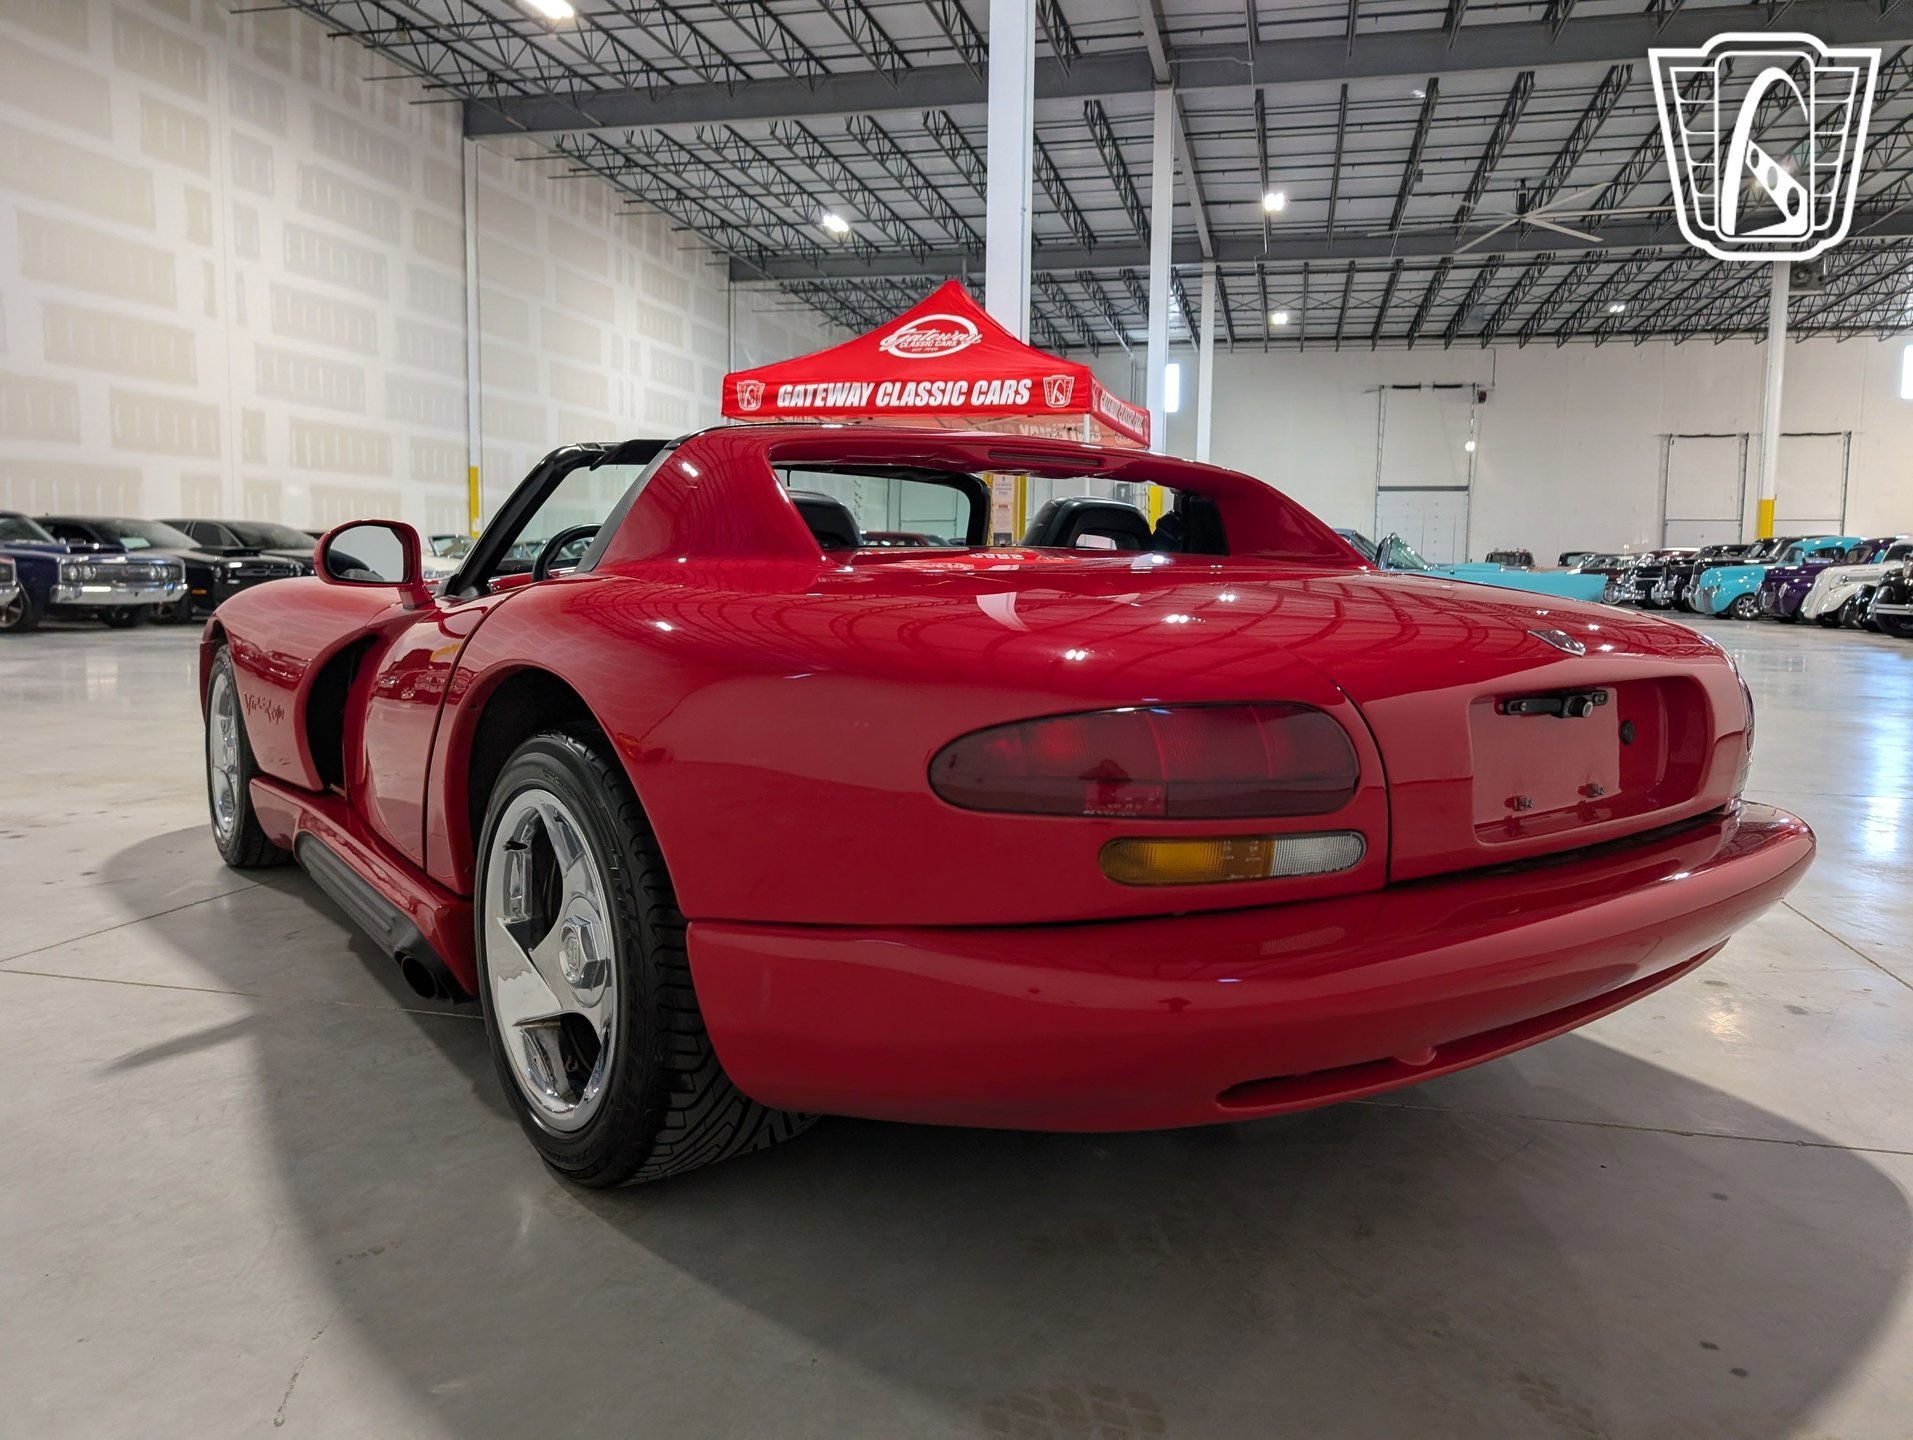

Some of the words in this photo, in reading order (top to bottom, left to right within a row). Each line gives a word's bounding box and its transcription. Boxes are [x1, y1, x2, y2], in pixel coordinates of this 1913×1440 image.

[879, 328, 983, 352] Gateway
[900, 340, 934, 348] CLASSIC
[777, 382, 875, 407] GATEWAY
[875, 381, 968, 407] CLASSIC
[970, 379, 1032, 406] CARS
